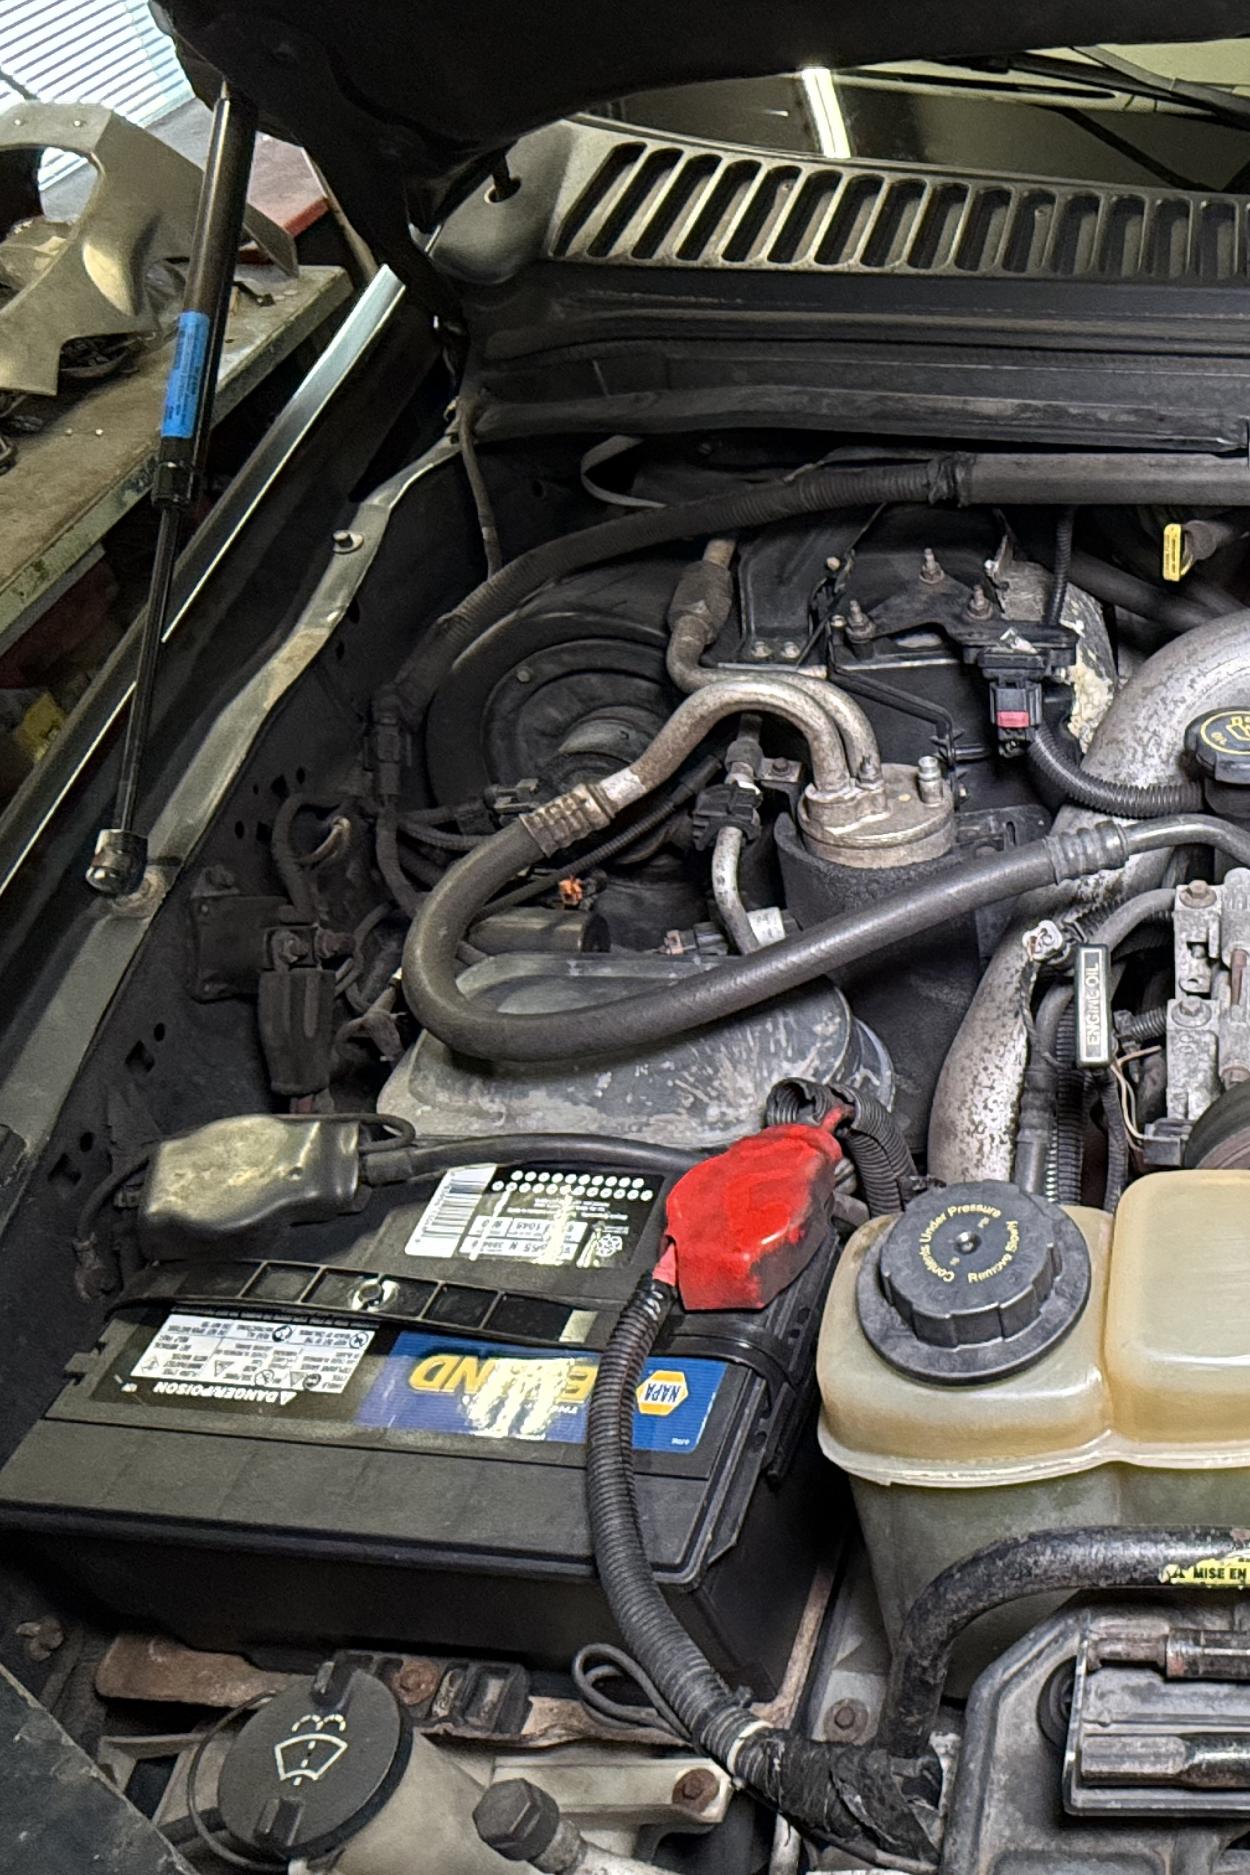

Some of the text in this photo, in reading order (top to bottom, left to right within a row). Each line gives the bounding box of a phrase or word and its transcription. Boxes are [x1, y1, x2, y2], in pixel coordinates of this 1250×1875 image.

[1085, 962, 1100, 1045] ENGINE OIL
[920, 1214, 947, 1243] Under
[947, 1203, 1002, 1218] Pressure
[967, 1252, 1013, 1284] Remove
[644, 1383, 682, 1403] NAPA
[1193, 1567, 1226, 1580] MISE
[1229, 1567, 1247, 1580] EN
